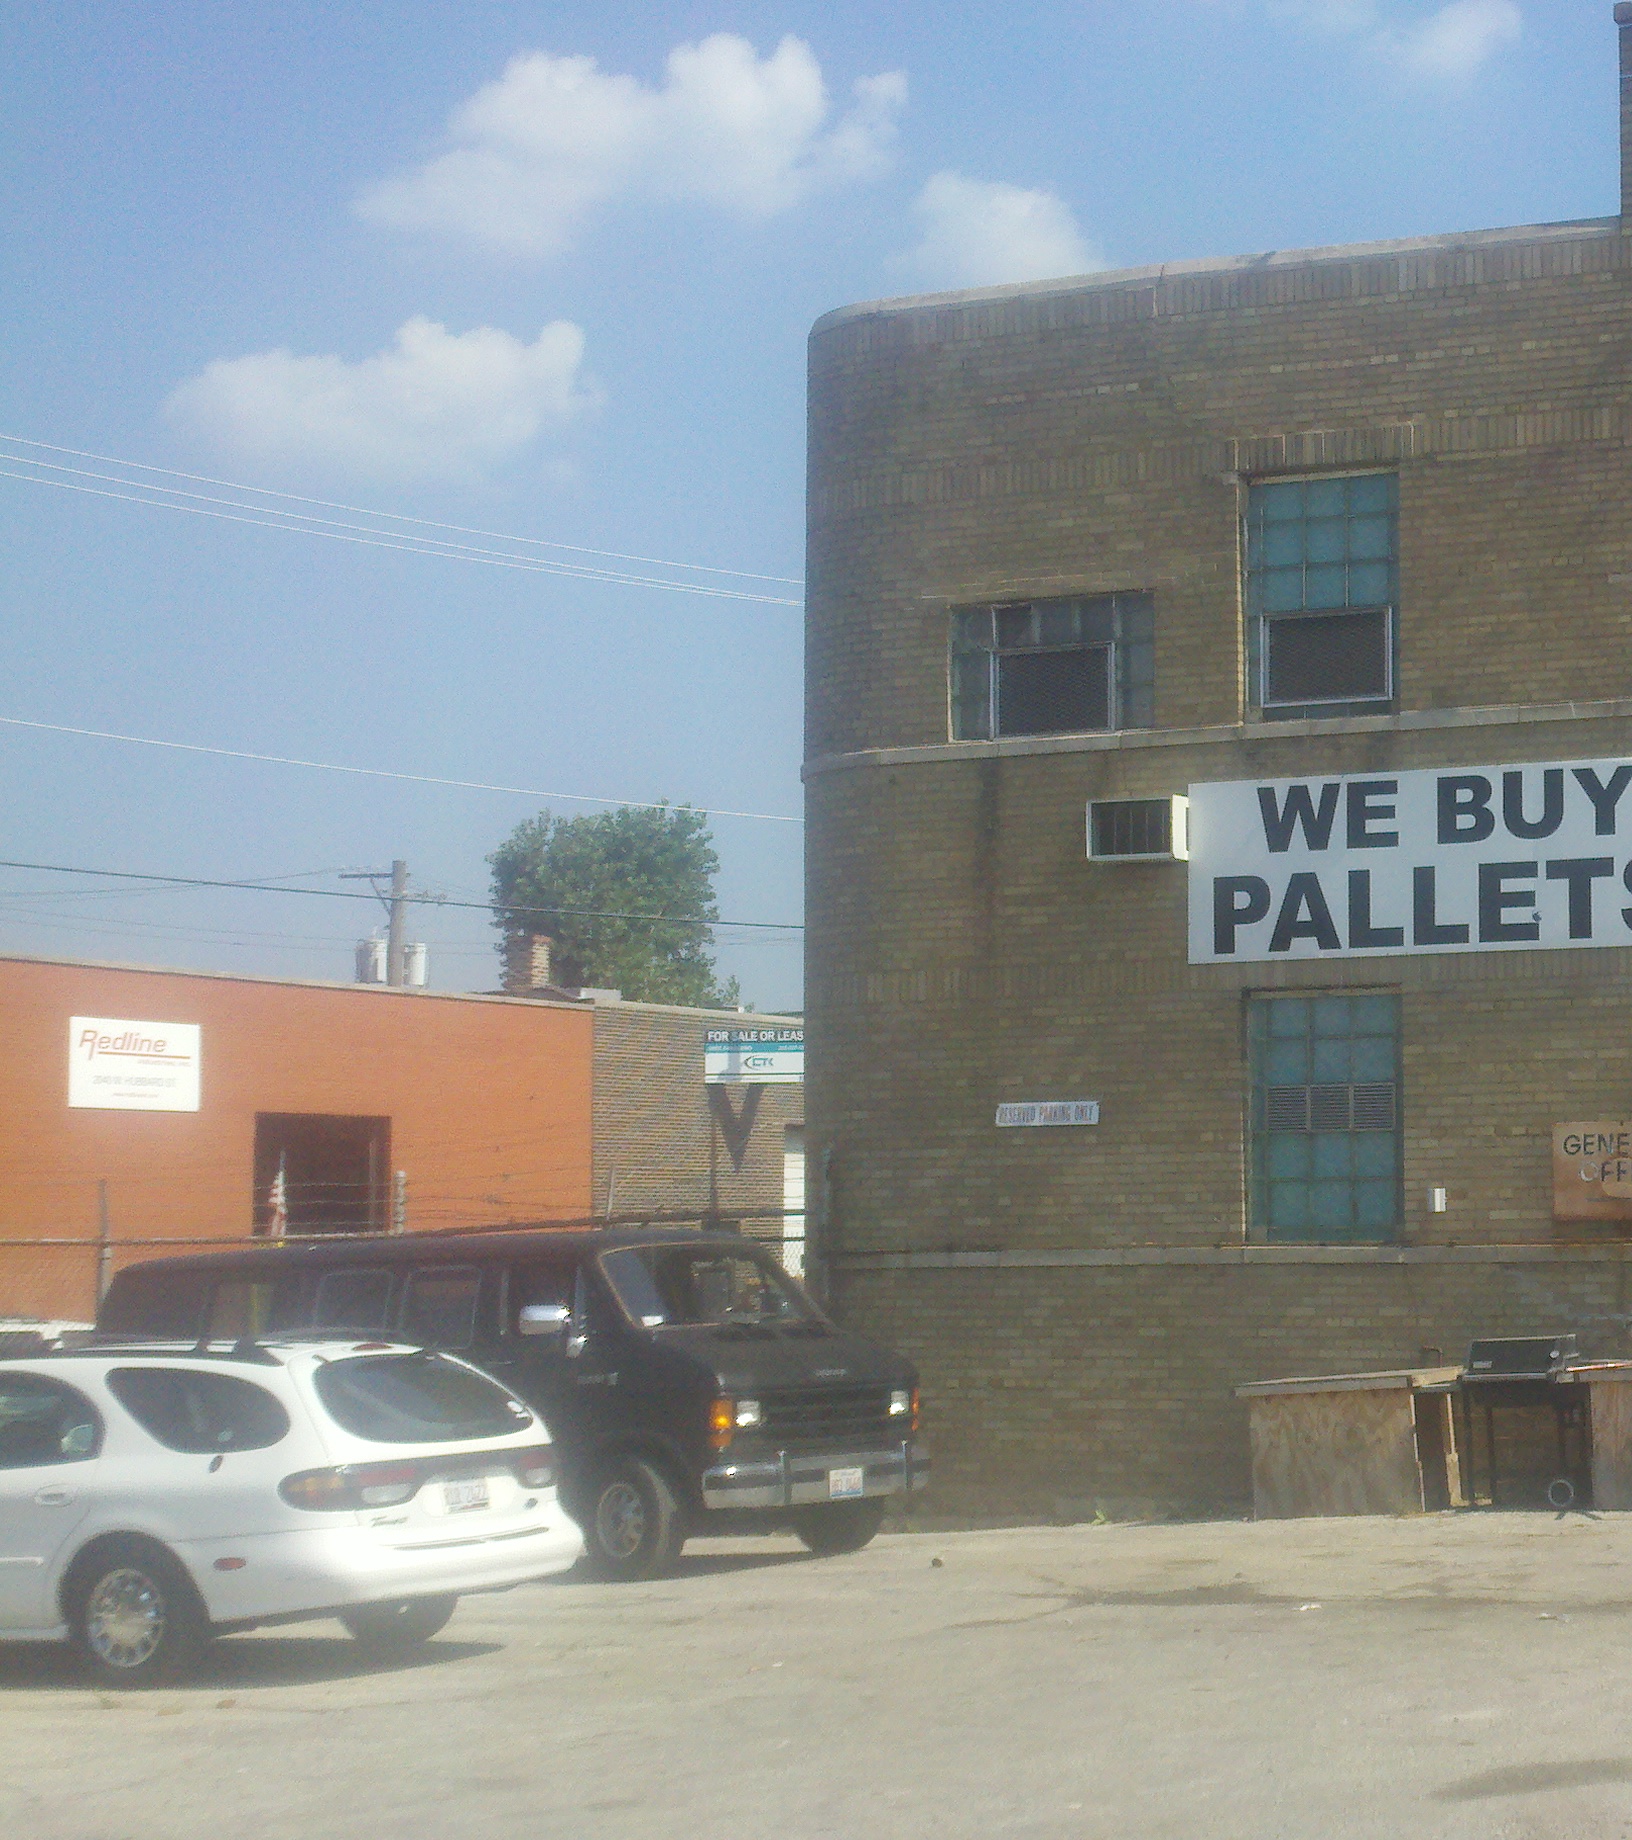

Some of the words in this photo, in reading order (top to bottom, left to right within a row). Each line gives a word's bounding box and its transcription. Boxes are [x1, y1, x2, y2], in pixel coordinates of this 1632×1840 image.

[1257, 780, 1400, 853] WE
[79, 1029, 168, 1061] Redline
[707, 1030, 729, 1042] FOR
[731, 1030, 758, 1042] SALE
[759, 1030, 776, 1042] OR
